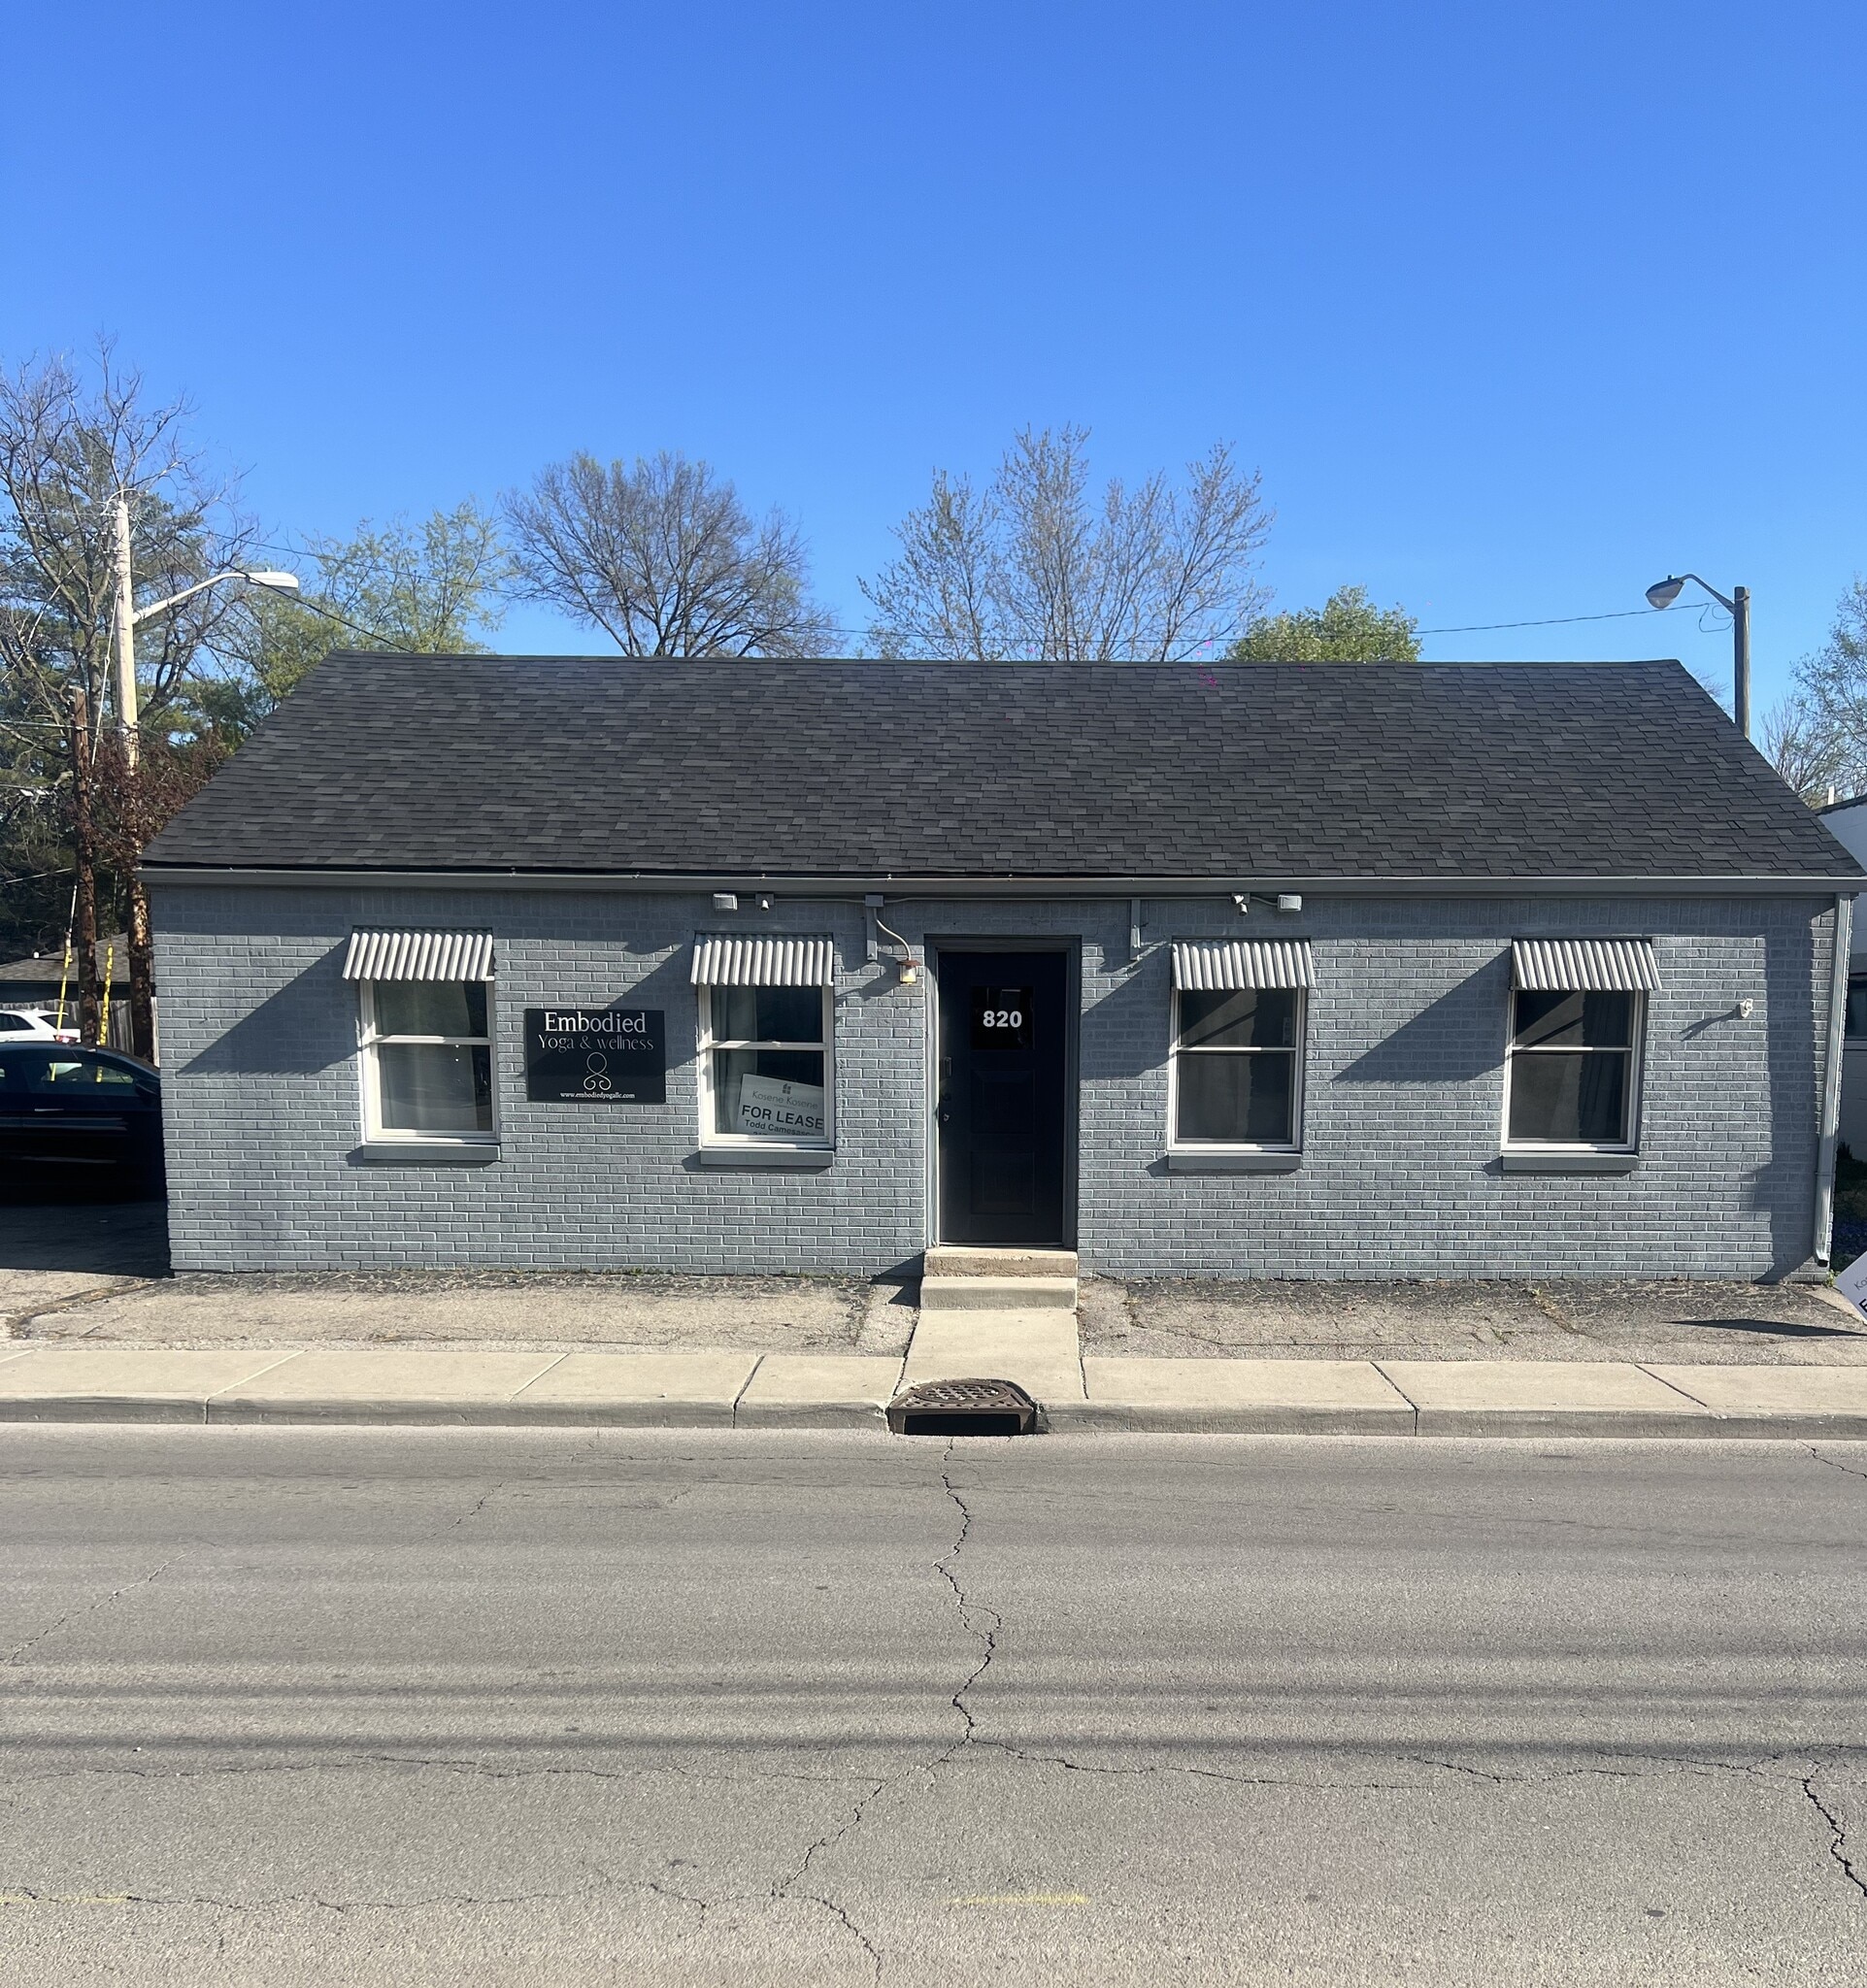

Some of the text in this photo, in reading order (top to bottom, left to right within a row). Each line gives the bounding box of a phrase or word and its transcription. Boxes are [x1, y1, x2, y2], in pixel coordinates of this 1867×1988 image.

[544, 1011, 648, 1034] Embodied
[983, 1010, 1022, 1028] 820
[538, 1034, 654, 1053] Yoga & wellness
[751, 1090, 783, 1104] Kosene
[786, 1096, 818, 1110] Kosene
[741, 1105, 824, 1130] FOR LEASE
[745, 1118, 766, 1130] Todd
